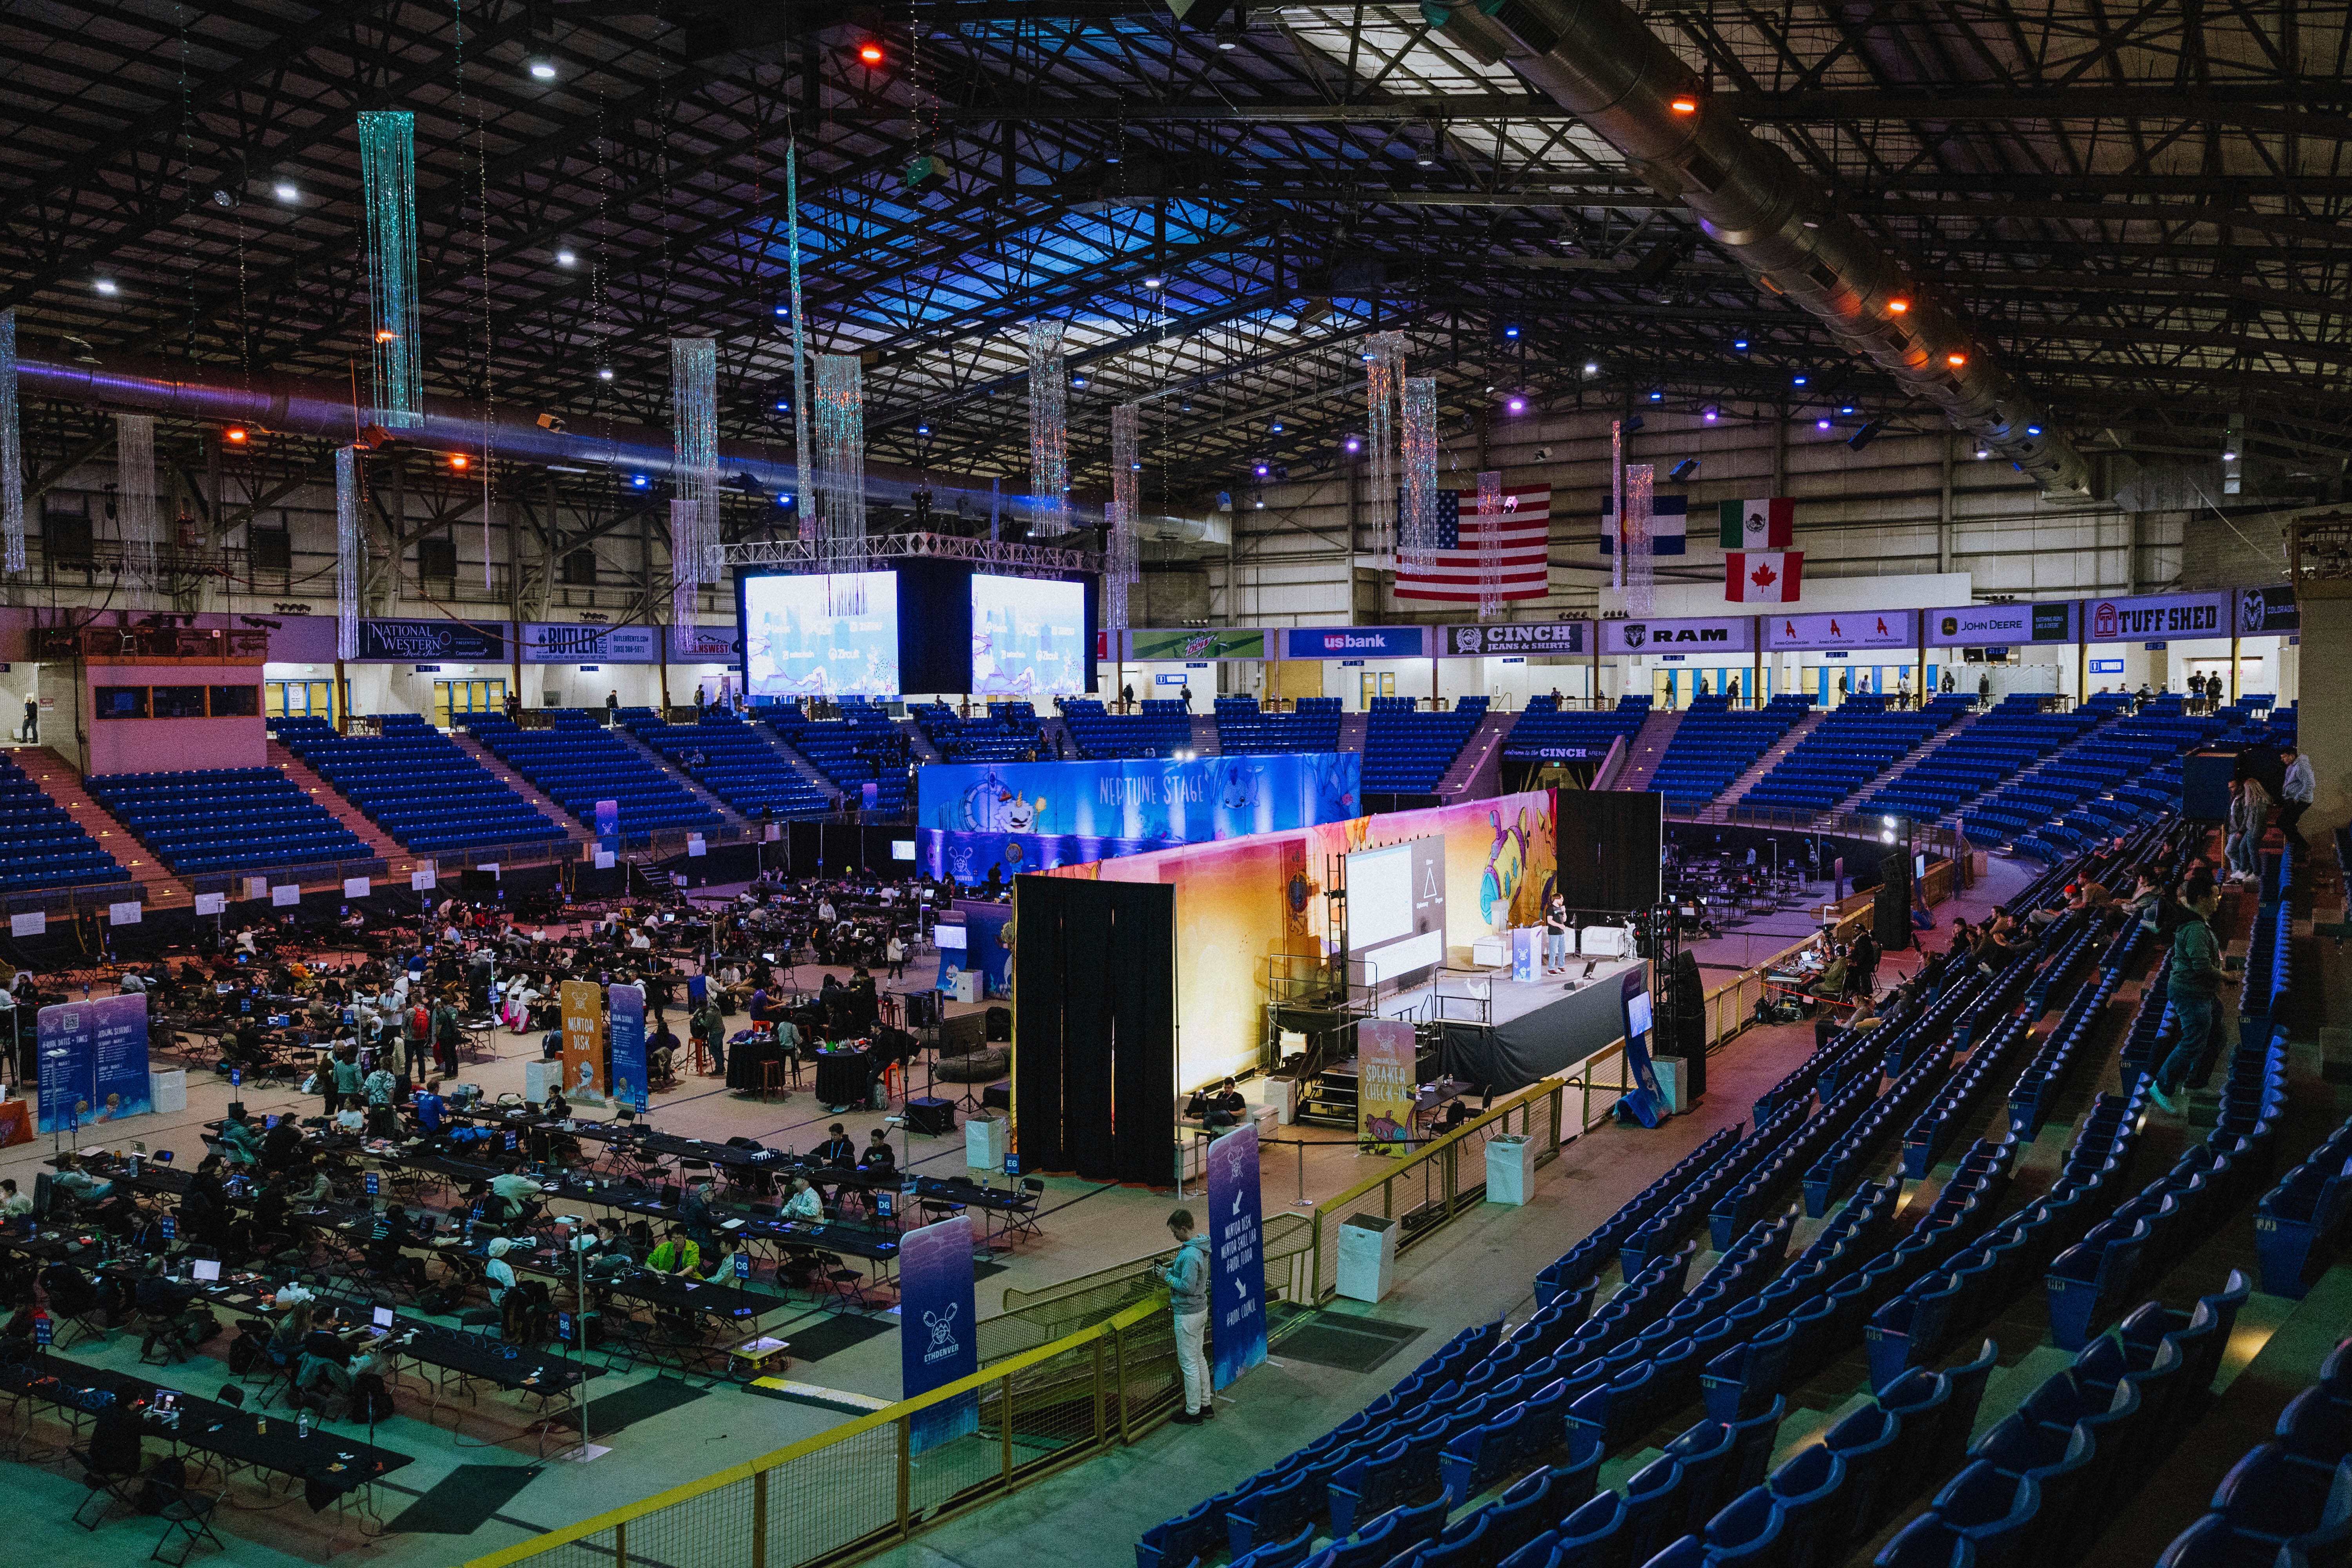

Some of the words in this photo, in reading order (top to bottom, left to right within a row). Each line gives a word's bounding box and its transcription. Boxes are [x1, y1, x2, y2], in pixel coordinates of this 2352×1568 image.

[1961, 621, 1987, 631] JOHN
[1989, 620, 2023, 630] DEERE
[2118, 609, 2165, 633] TUFF
[2168, 606, 2217, 631] SHED
[370, 623, 433, 638] NATIONAL
[1487, 626, 1571, 642] CINCH
[1653, 629, 1728, 642] RAM
[382, 636, 441, 651] WESTERN
[548, 627, 598, 654] BUTLER
[598, 628, 608, 654] RENTS
[1487, 643, 1519, 652] JEANS
[2100, 661, 2122, 671] WOMEN
[1539, 748, 1587, 758] CINCH
[1100, 775, 1157, 806] NEPTUNE
[1163, 775, 1203, 805] STAGE
[568, 1017, 594, 1034] MENTOR
[573, 1035, 590, 1051] DESK
[1366, 1064, 1406, 1085] SPEAKER
[1365, 1083, 1407, 1102] CHECK-IN
[878, 1201, 890, 1209] D6
[1225, 1220, 1241, 1241] MENTOR
[1241, 1213, 1252, 1232] DESK
[1221, 1239, 1237, 1260] MENTOR
[1238, 1232, 1248, 1251] SKILL
[736, 1261, 748, 1270] C6
[1226, 1254, 1240, 1274] #BUIDL
[1241, 1247, 1252, 1266] FLOOR
[1226, 1307, 1240, 1327] #BUIDL
[1241, 1297, 1256, 1319] COUNCIL
[560, 1319, 570, 1331] B6
[924, 1343, 959, 1363] ETHDENVER
